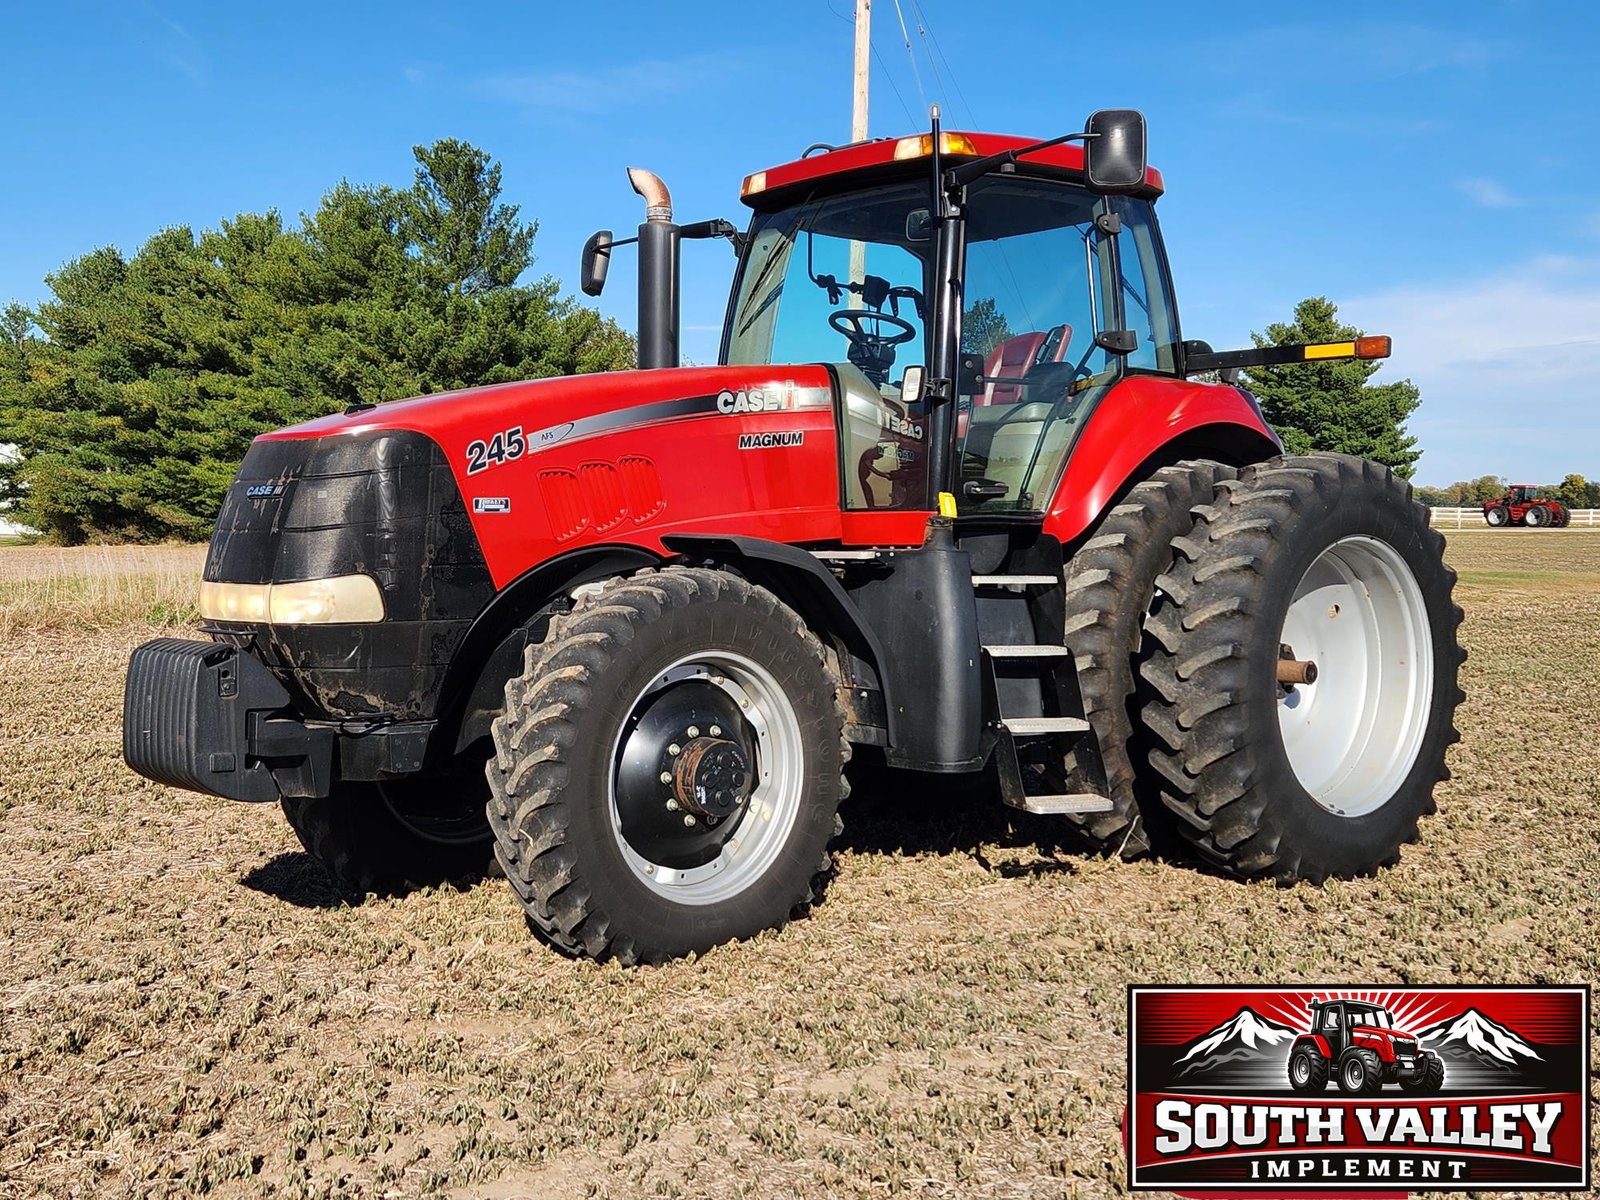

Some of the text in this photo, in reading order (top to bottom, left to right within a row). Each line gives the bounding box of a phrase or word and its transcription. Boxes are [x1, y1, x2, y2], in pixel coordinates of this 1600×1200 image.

[716, 390, 779, 414] CASE
[541, 431, 554, 441] AFS
[738, 432, 804, 449] MAGNUM
[467, 426, 525, 475] 245
[246, 485, 273, 496] CASE
